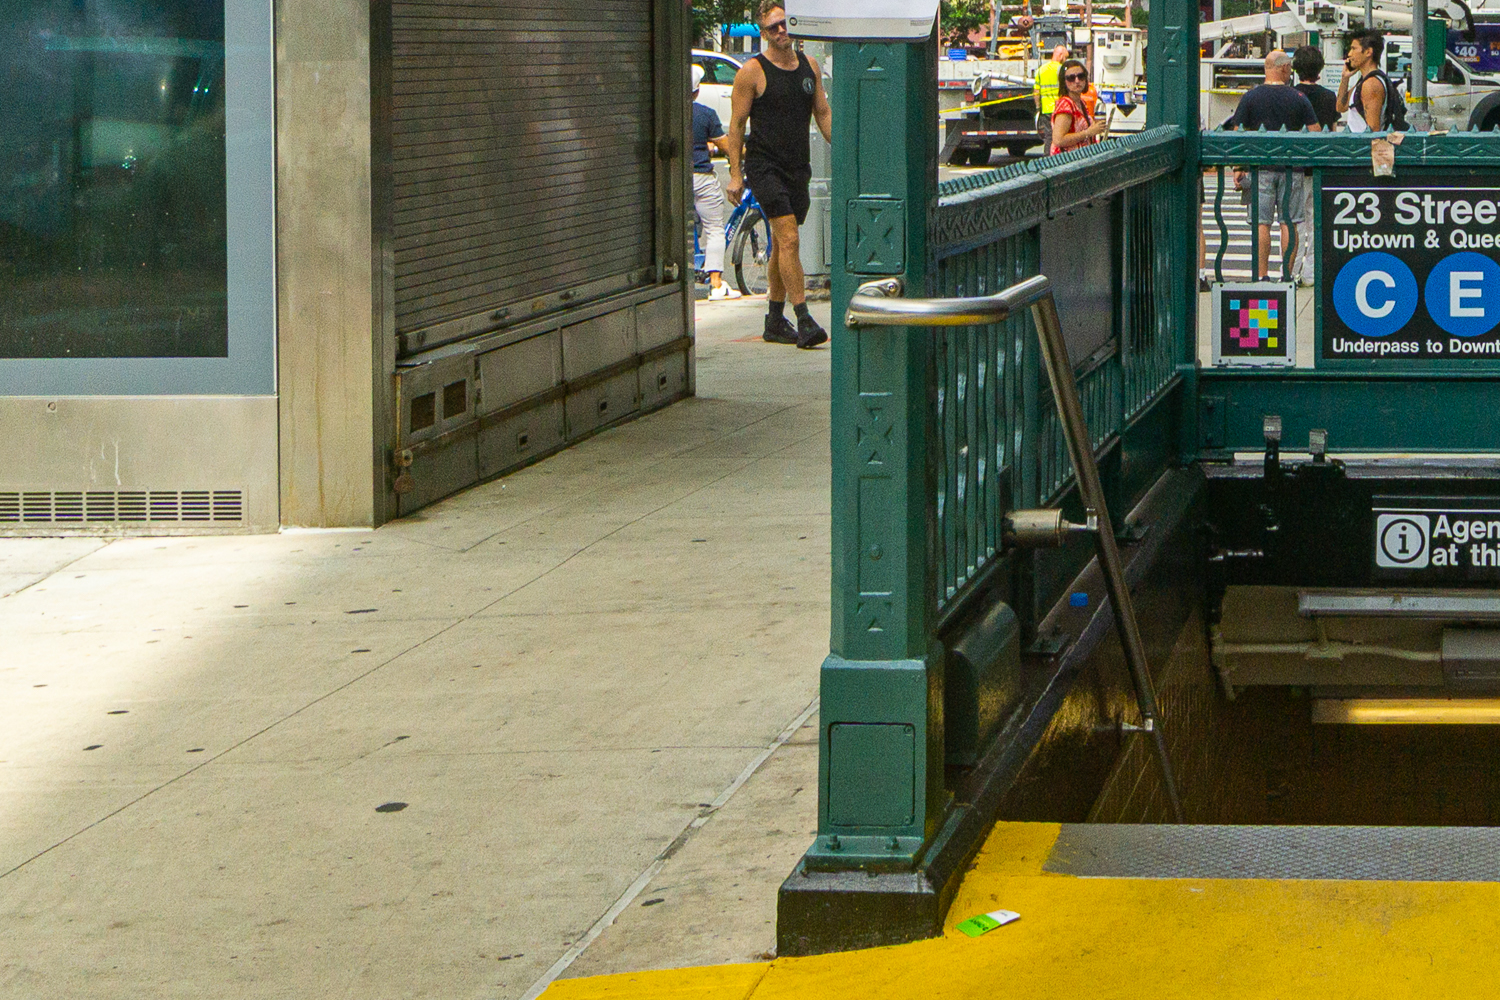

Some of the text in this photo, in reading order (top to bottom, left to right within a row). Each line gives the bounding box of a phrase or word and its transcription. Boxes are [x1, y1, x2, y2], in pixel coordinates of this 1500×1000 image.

[1455, 46, 1477, 56] $40
[1333, 192, 1381, 225] 23
[1333, 230, 1415, 252] Uptown
[1424, 231, 1440, 249] &
[1355, 270, 1485, 319] C E
[1333, 338, 1419, 355] Underpass
[1426, 339, 1443, 354] to
[1431, 545, 1459, 567] at
